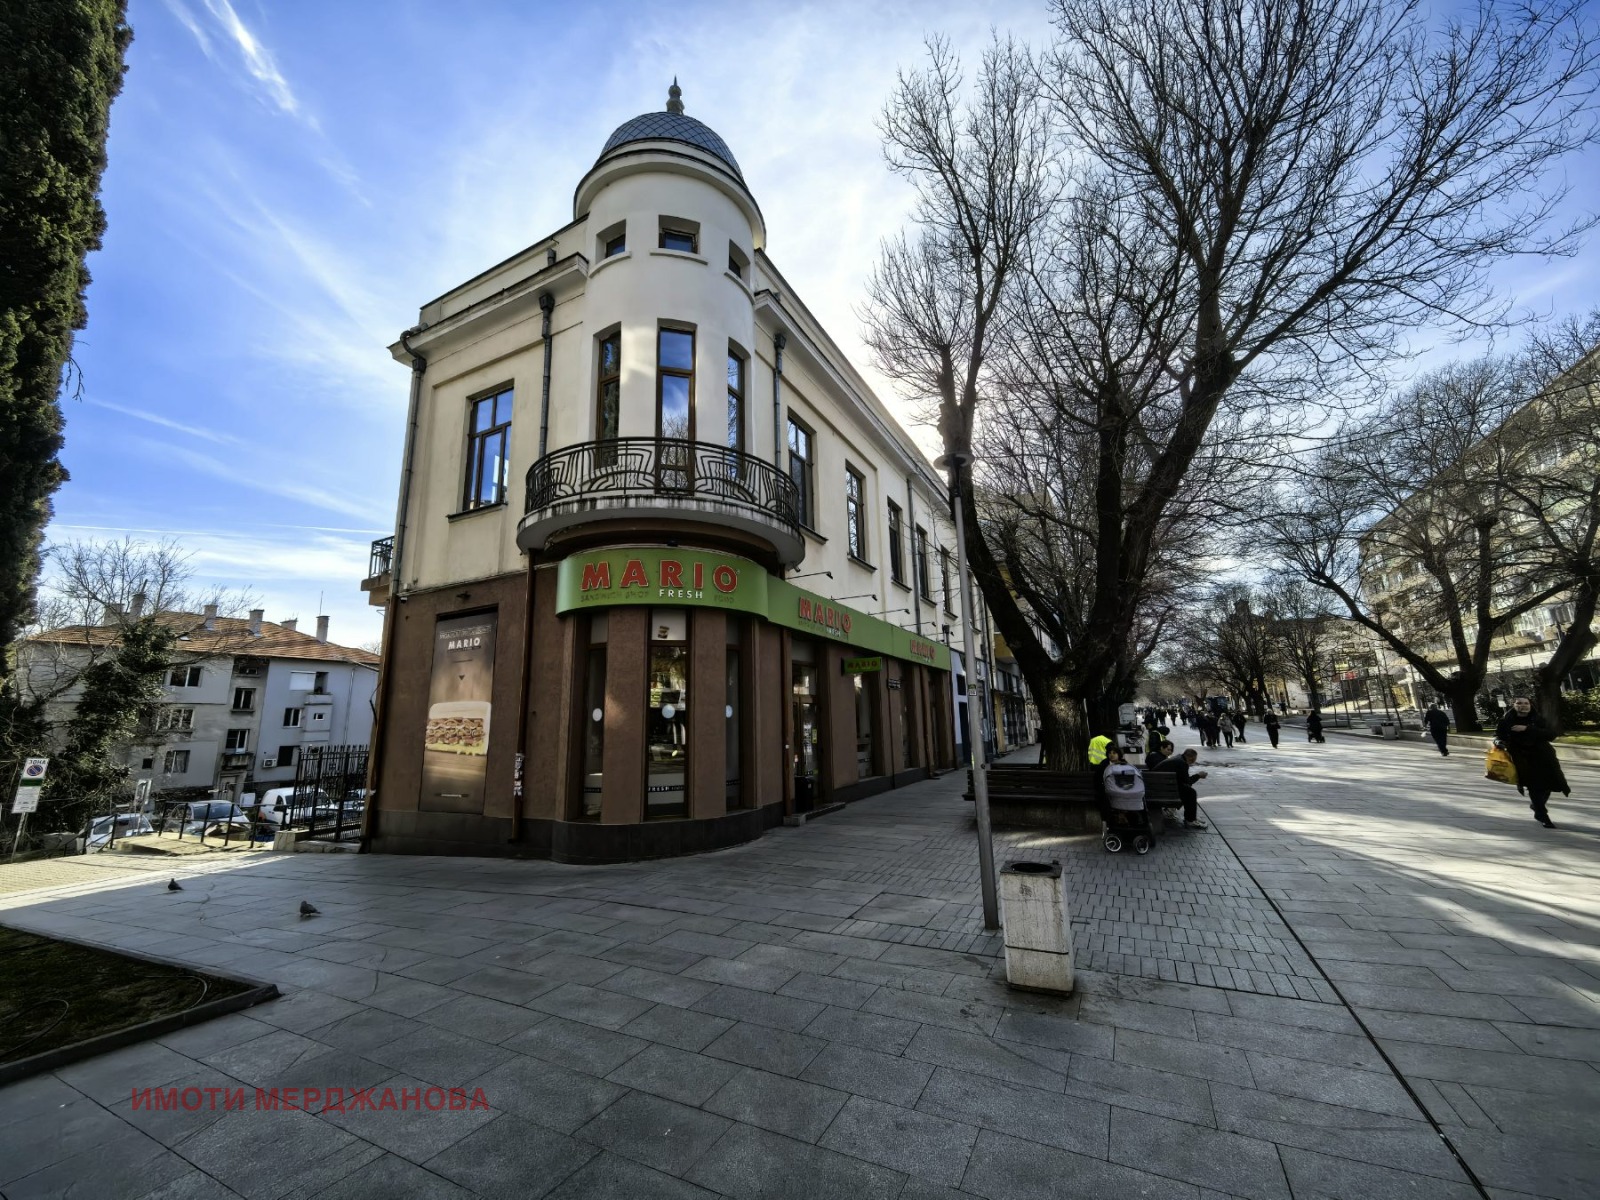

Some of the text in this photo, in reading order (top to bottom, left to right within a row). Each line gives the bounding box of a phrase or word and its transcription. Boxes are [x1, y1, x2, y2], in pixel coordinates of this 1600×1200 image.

[580, 559, 738, 593] MARIO
[659, 589, 703, 599] FRESH
[799, 597, 852, 633] MARIO
[447, 637, 481, 650] MARIO
